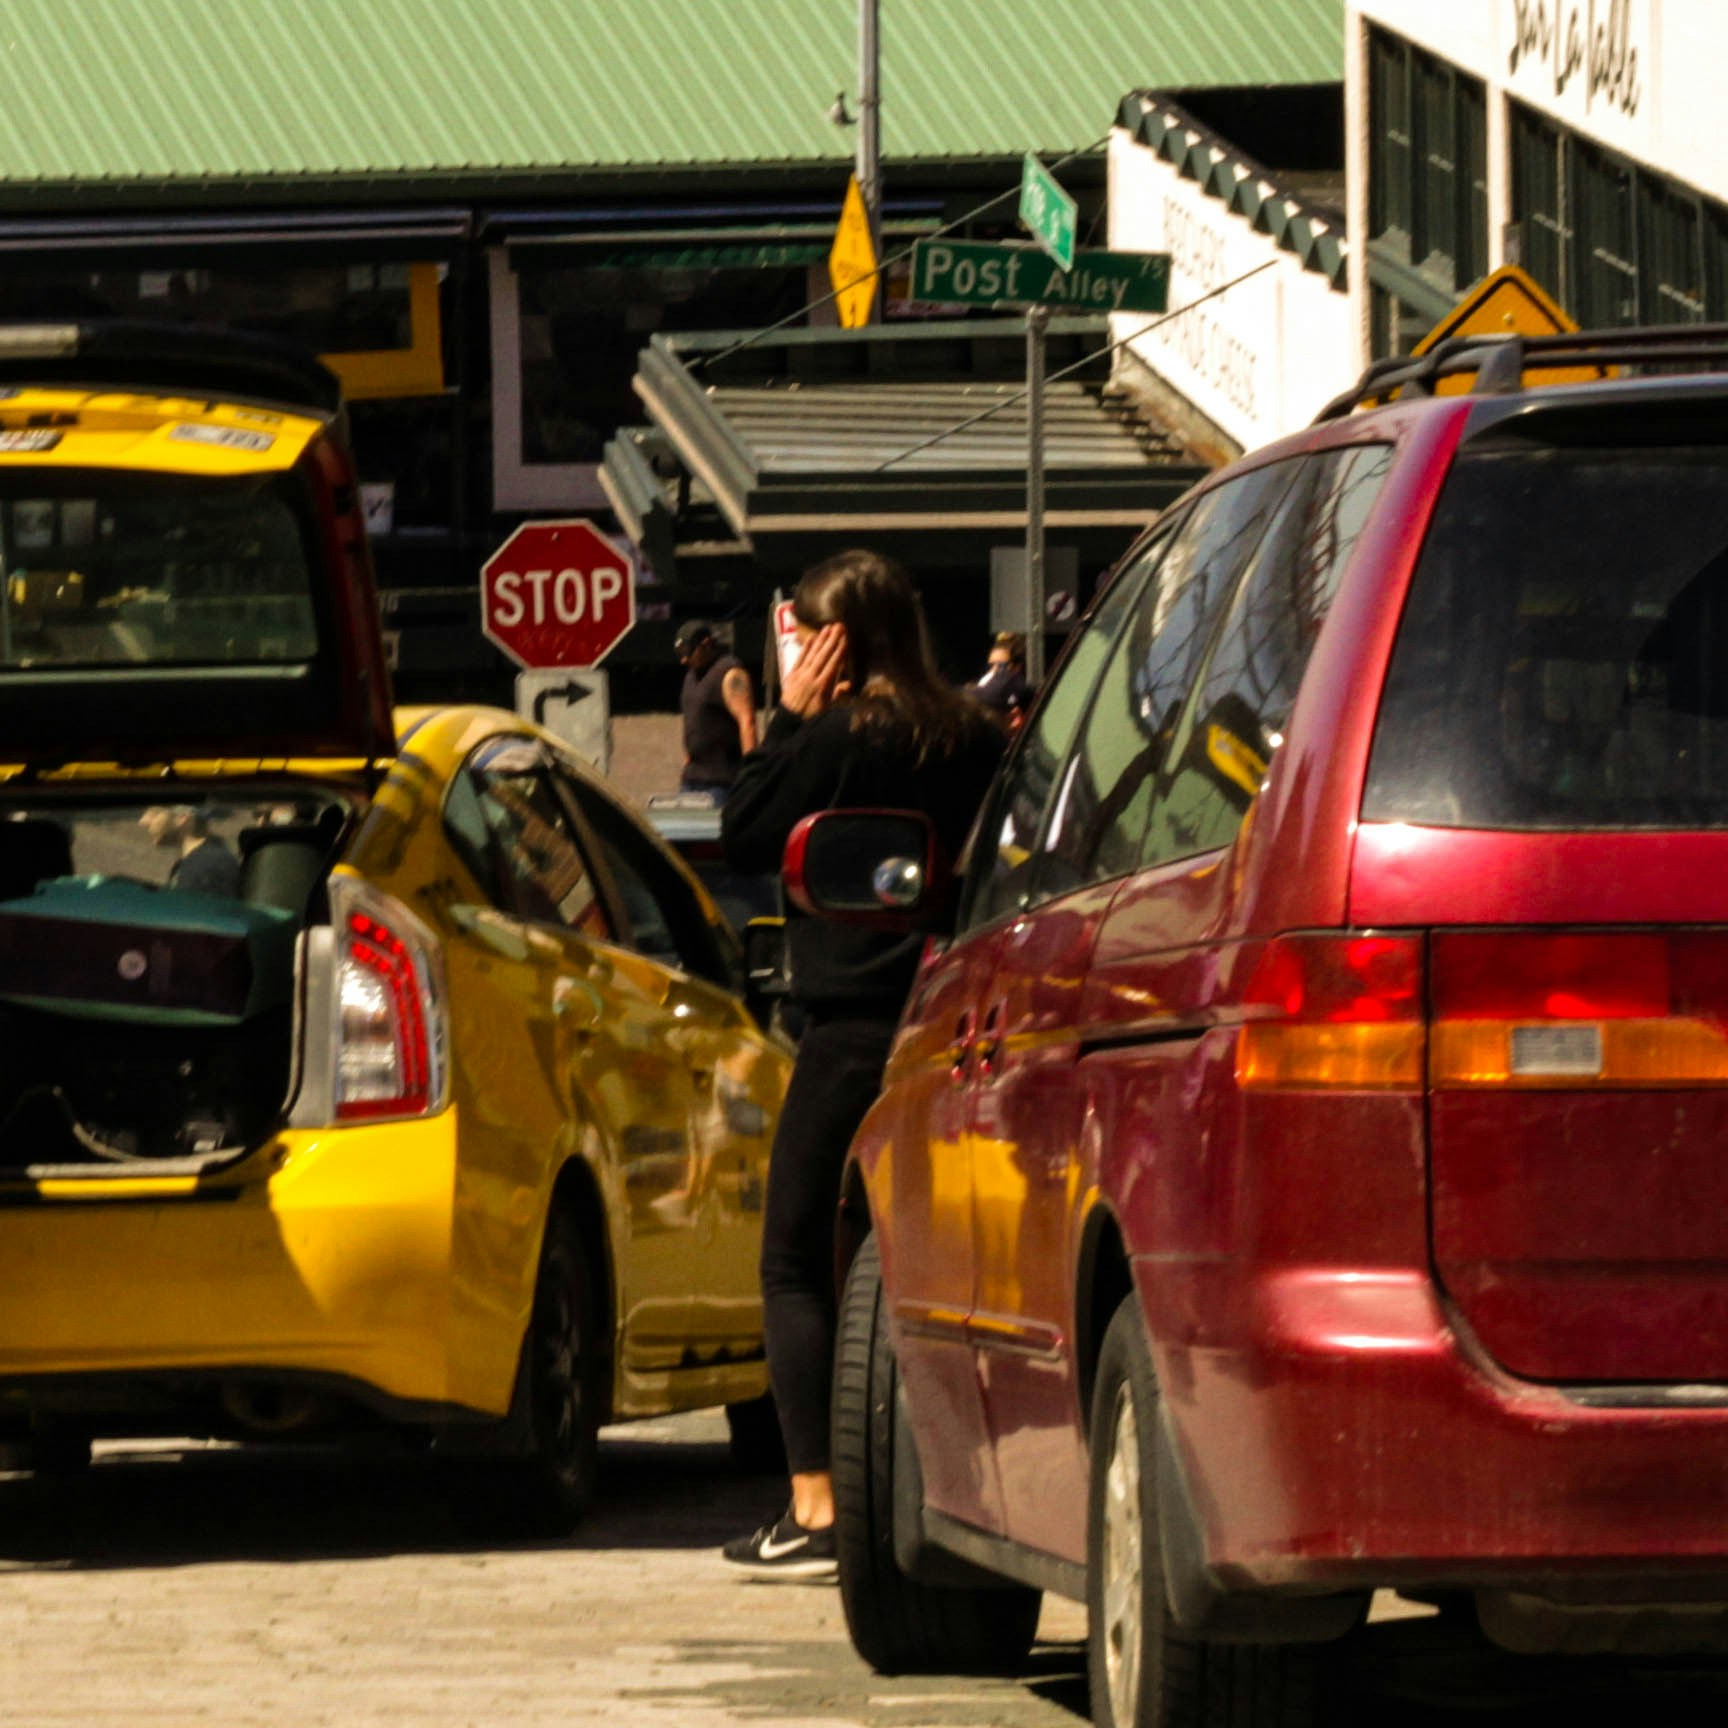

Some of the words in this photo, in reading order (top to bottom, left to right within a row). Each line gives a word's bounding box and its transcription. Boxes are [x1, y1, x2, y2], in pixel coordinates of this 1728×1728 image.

[924, 246, 1022, 298] Post
[1043, 268, 1130, 308] Alley
[493, 567, 623, 626] STOP
